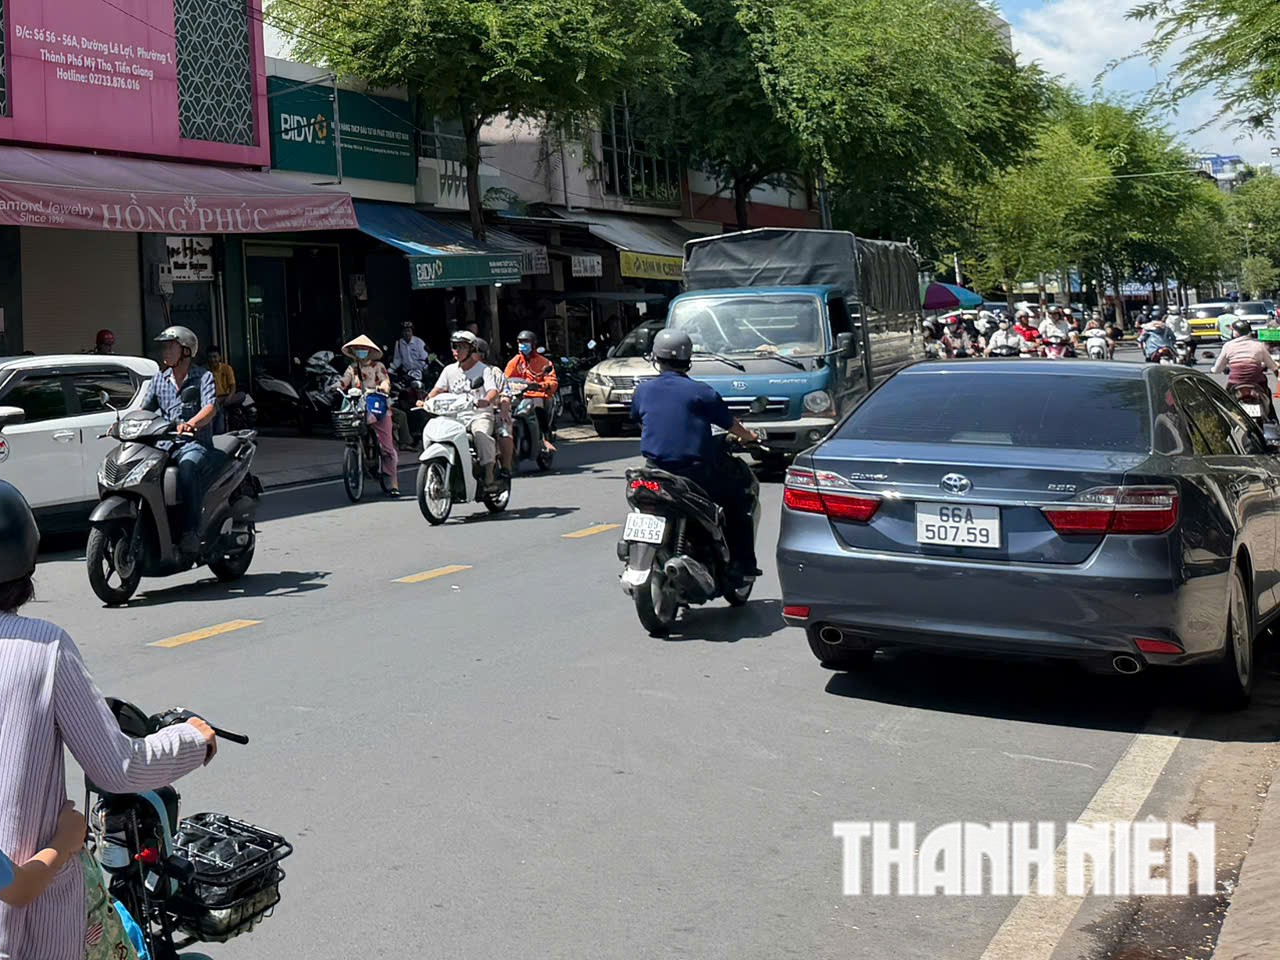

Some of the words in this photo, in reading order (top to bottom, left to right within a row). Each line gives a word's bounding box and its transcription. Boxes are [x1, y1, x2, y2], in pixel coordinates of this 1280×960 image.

[16, 25, 33, 39] Đ/c:
[34, 28, 45, 41] Số
[46, 31, 56, 43] 56
[62, 34, 80, 48] 56A,
[81, 37, 109, 55] Đường
[109, 42, 119, 54] Lê
[137, 47, 166, 65] Phường
[40, 49, 66, 64] Thành
[67, 53, 83, 66] Phố
[84, 56, 96, 71] Mỹ
[97, 58, 114, 73] Tho,
[132, 64, 154, 80] Giang
[57, 67, 88, 83] Hotline:
[280, 113, 315, 144] BIDV
[20, 211, 46, 224] Since
[45, 201, 94, 219] Jewelry
[100, 193, 187, 232] HỒNG
[199, 201, 271, 232] PHÚC
[416, 262, 436, 281] BIDV
[939, 506, 974, 524] 66A
[925, 524, 990, 544] 507.59
